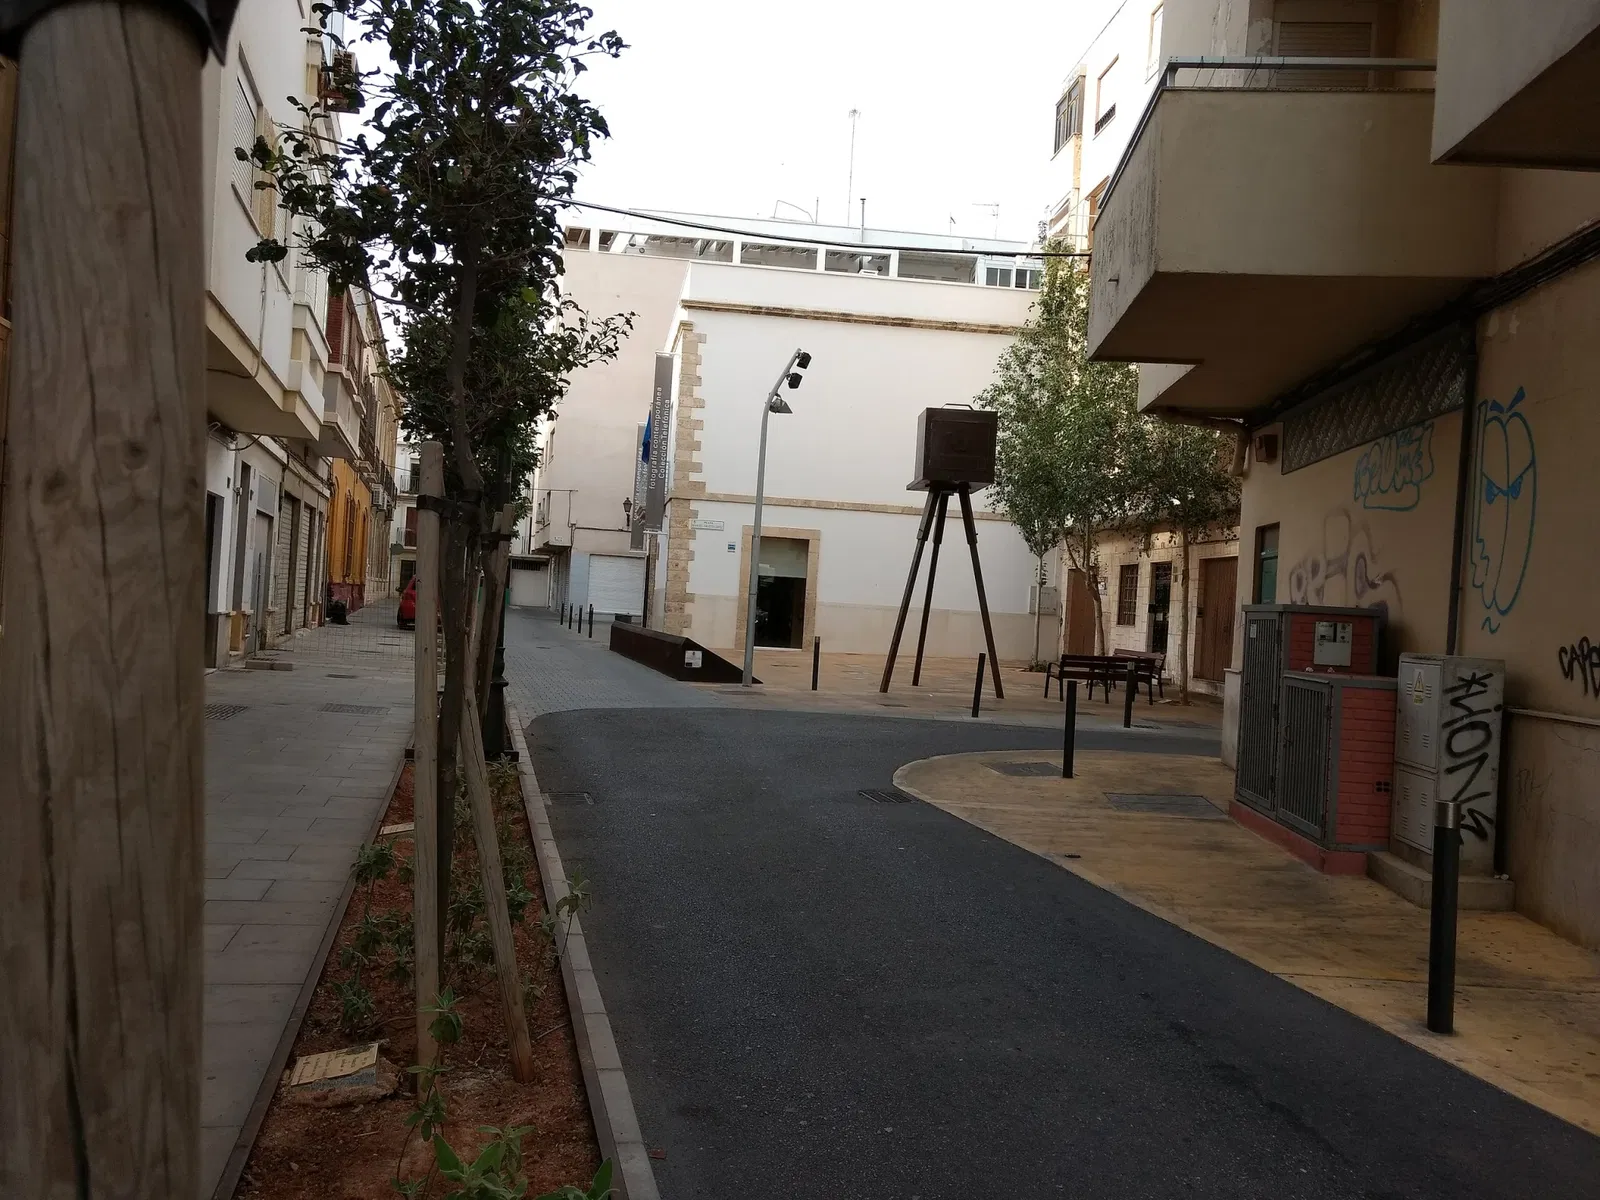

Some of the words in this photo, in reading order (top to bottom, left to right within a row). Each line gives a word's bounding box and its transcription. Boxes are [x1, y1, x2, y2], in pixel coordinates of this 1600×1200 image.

[653, 387, 663, 448] contemporánea
[661, 400, 670, 438] Telefónica
[649, 450, 658, 489] fotografía
[658, 442, 668, 478] Colección
